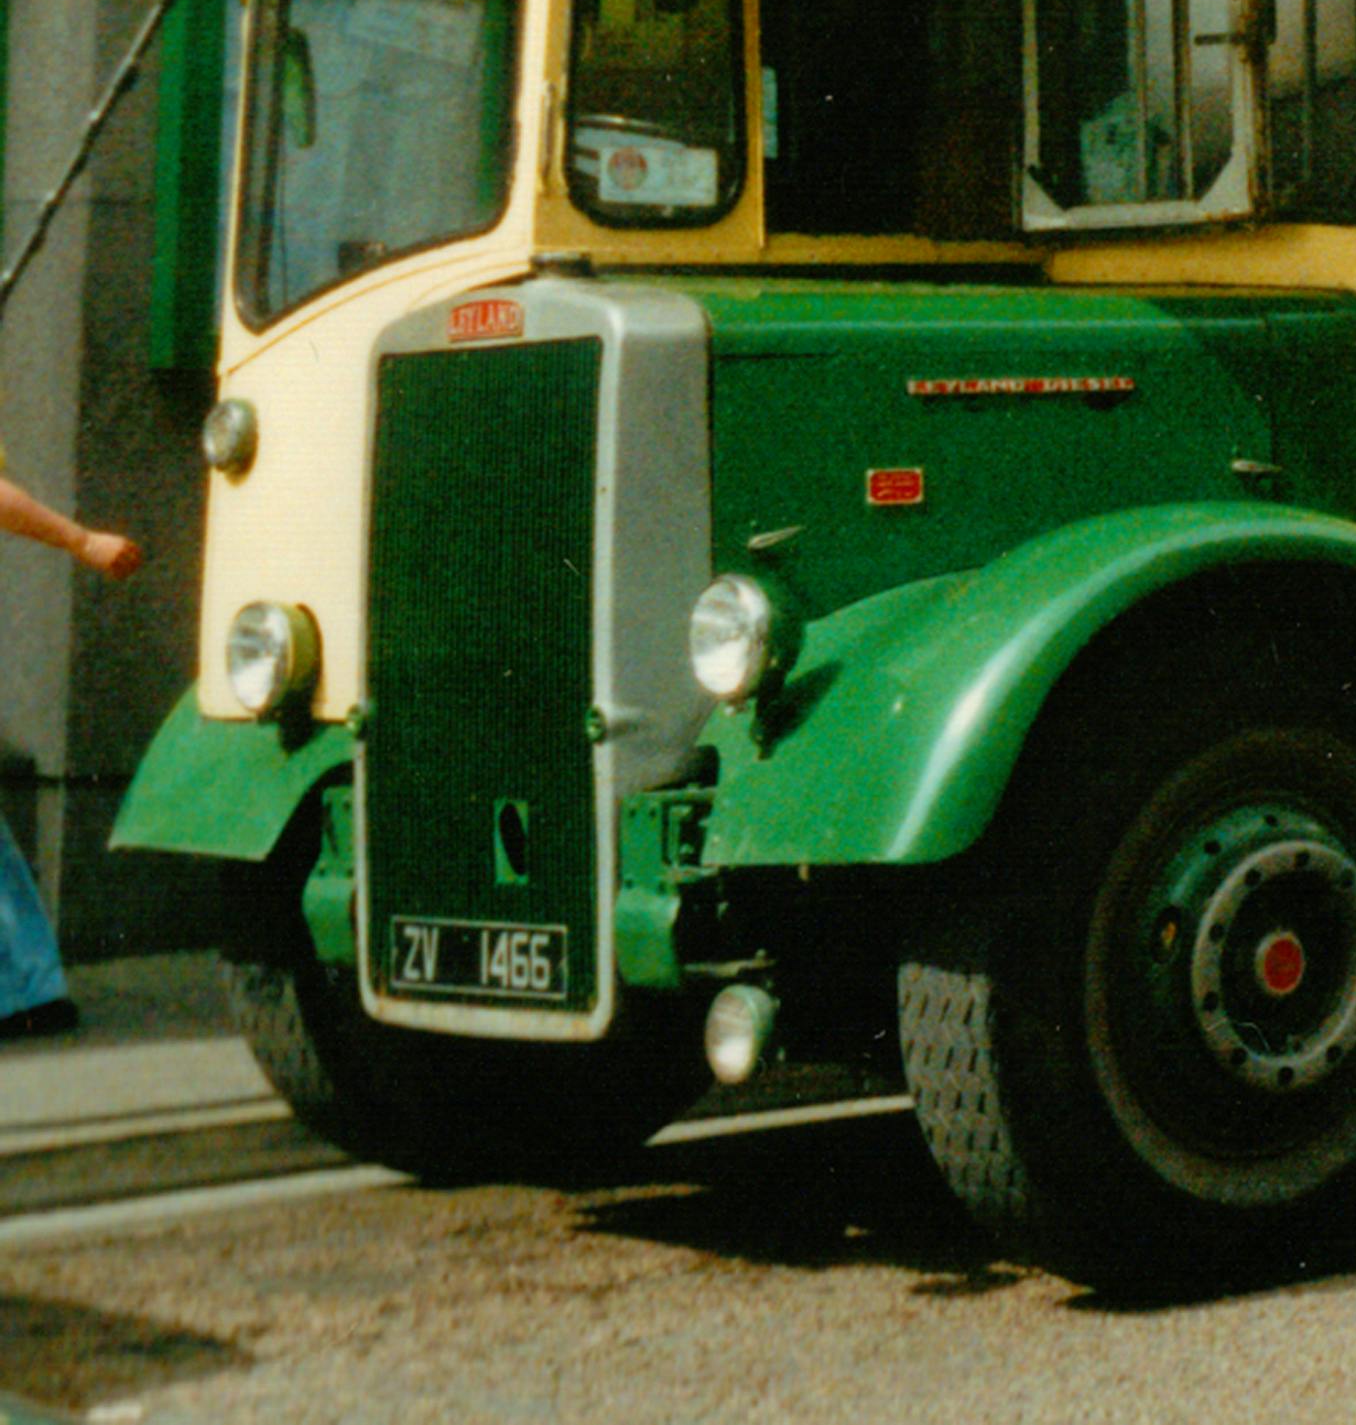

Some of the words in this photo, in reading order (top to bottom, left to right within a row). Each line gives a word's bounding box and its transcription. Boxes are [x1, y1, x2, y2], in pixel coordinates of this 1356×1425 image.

[449, 303, 520, 336] LEYLAND
[403, 926, 439, 982] ZV
[481, 929, 550, 990] 1466
